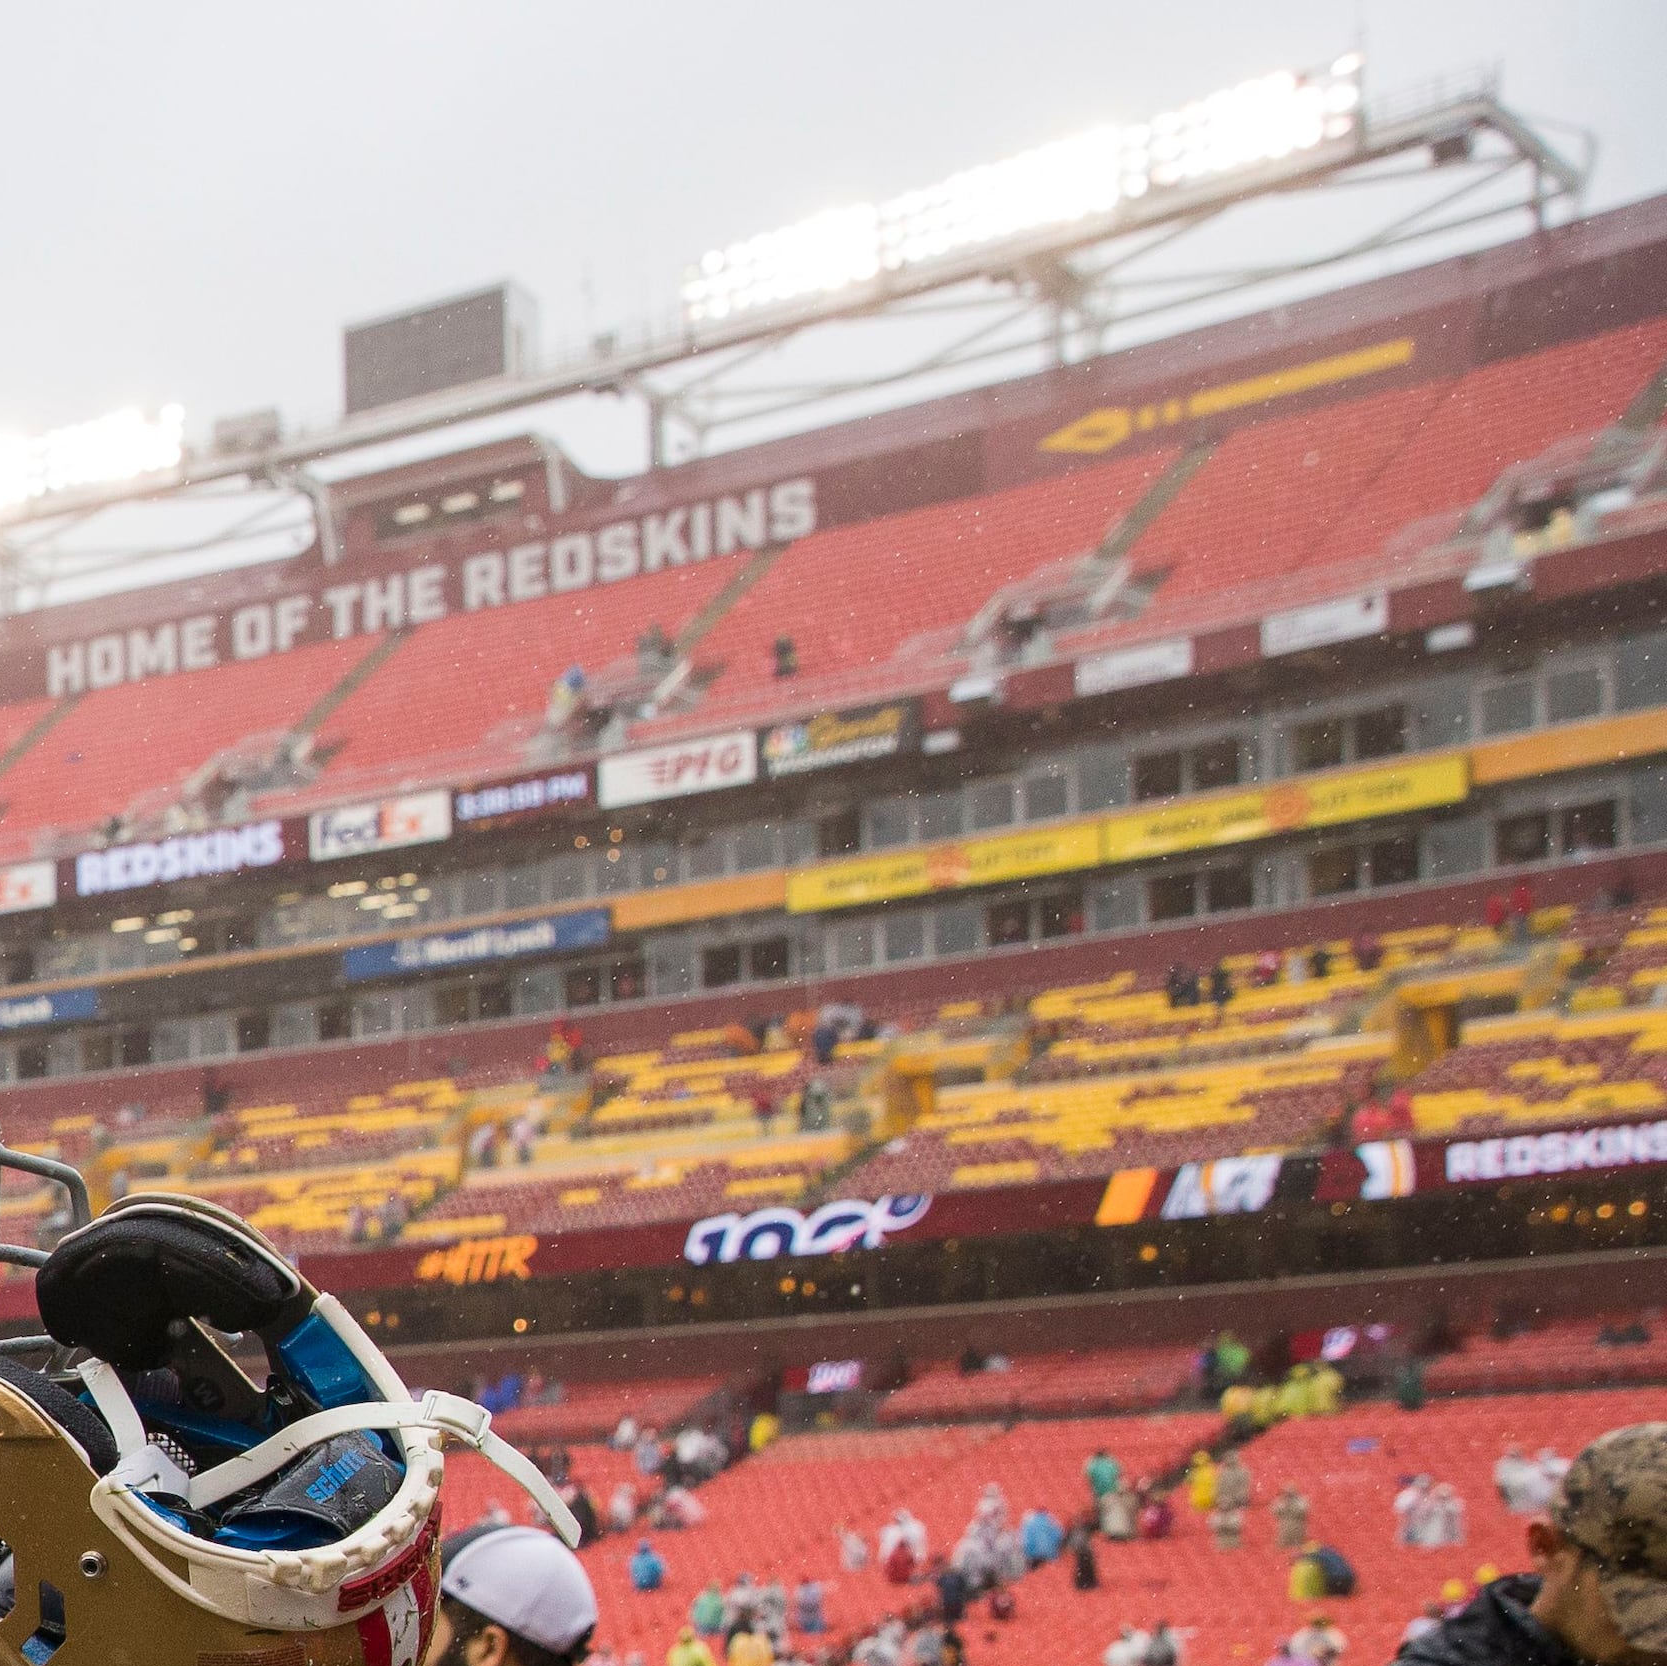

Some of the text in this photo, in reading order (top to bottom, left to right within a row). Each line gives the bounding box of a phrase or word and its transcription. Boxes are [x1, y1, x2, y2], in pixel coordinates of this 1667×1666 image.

[48, 478, 817, 697] HOME OF THE REDSKINS
[75, 820, 285, 898] REDSKINS
[320, 806, 424, 847] FedEx
